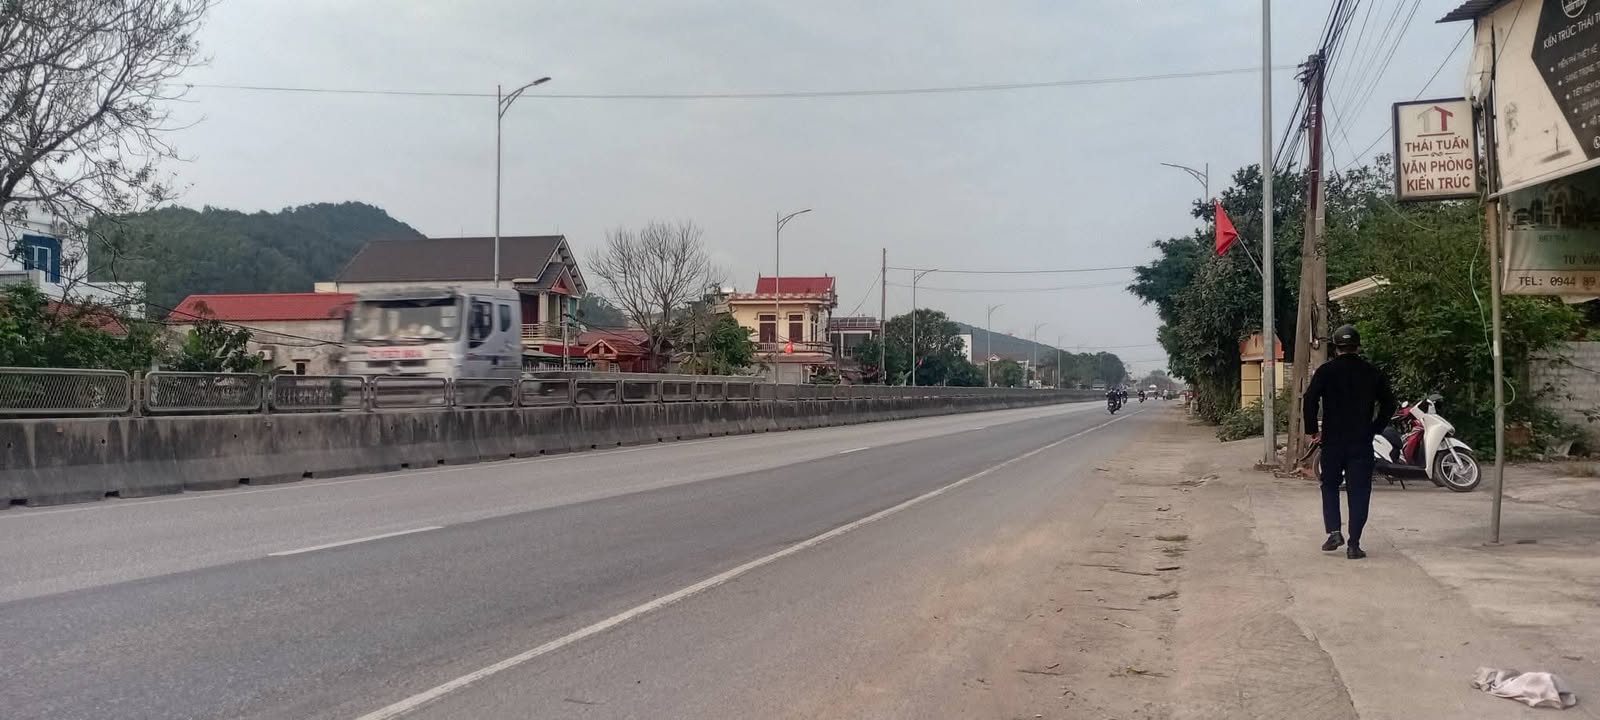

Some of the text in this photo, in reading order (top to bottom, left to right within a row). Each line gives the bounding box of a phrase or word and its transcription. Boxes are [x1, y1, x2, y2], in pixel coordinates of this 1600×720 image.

[1557, 25, 1577, 41] TRÚC
[1577, 14, 1595, 32] THÁI
[1405, 135, 1469, 153] THÁI TUẤN
[1402, 156, 1473, 175] VĂN PHÒNG
[1406, 173, 1471, 192] KIẾN TRÚC
[1519, 276, 1543, 286] TEL:
[1550, 276, 1576, 287] 0944
